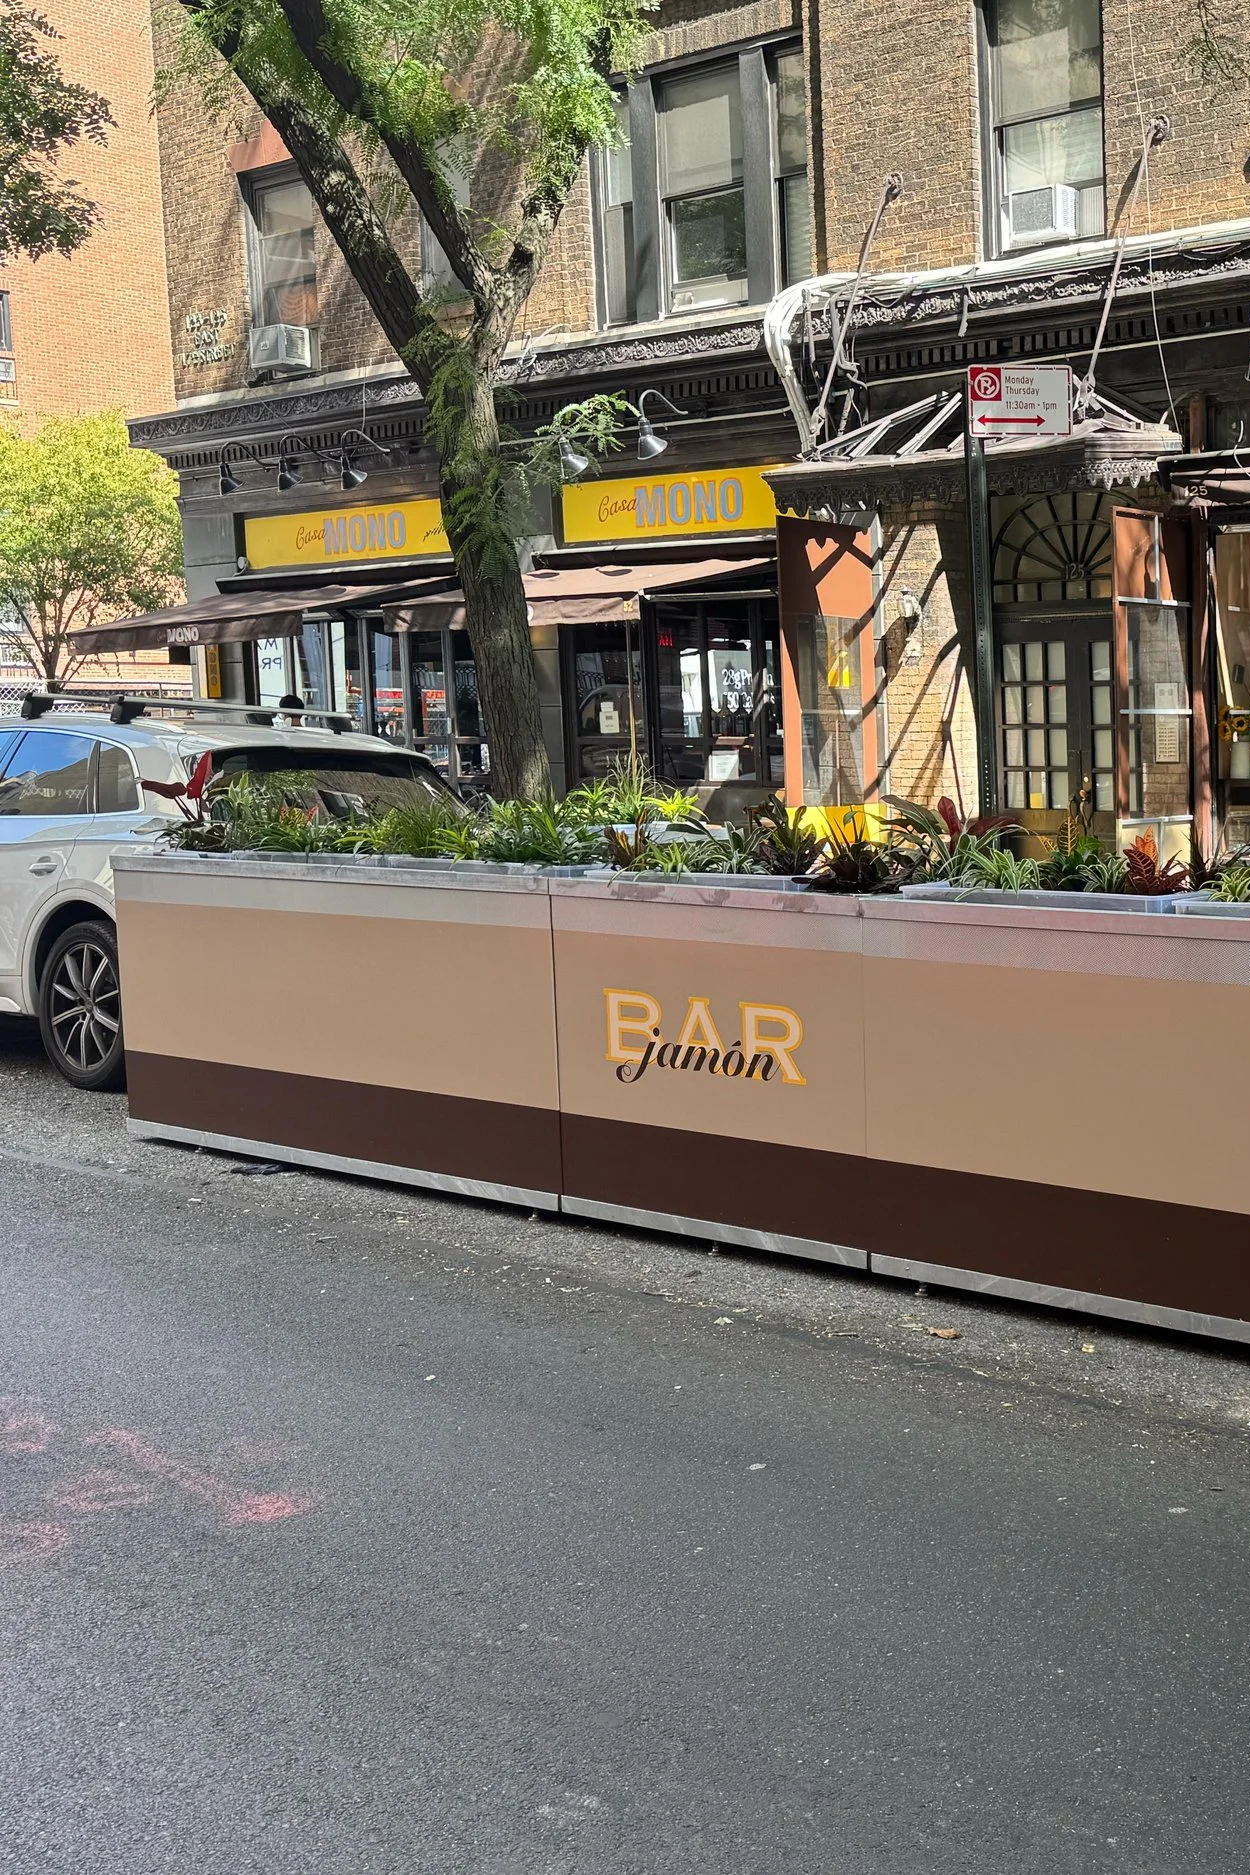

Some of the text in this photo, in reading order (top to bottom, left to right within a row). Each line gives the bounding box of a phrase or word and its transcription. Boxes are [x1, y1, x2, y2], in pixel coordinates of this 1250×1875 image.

[1004, 375, 1034, 385] Monday
[1005, 386, 1040, 396] Thursday
[1006, 400, 1036, 410] 11:30am
[1042, 401, 1057, 412] 1pm
[1184, 485, 1209, 497] 125
[597, 477, 744, 529] Casa MONO
[296, 509, 407, 556] Casa MONO
[1065, 562, 1086, 582] 125
[166, 626, 200, 644] MONO
[603, 987, 807, 1086] BAR
[615, 1026, 782, 1084] jamón
